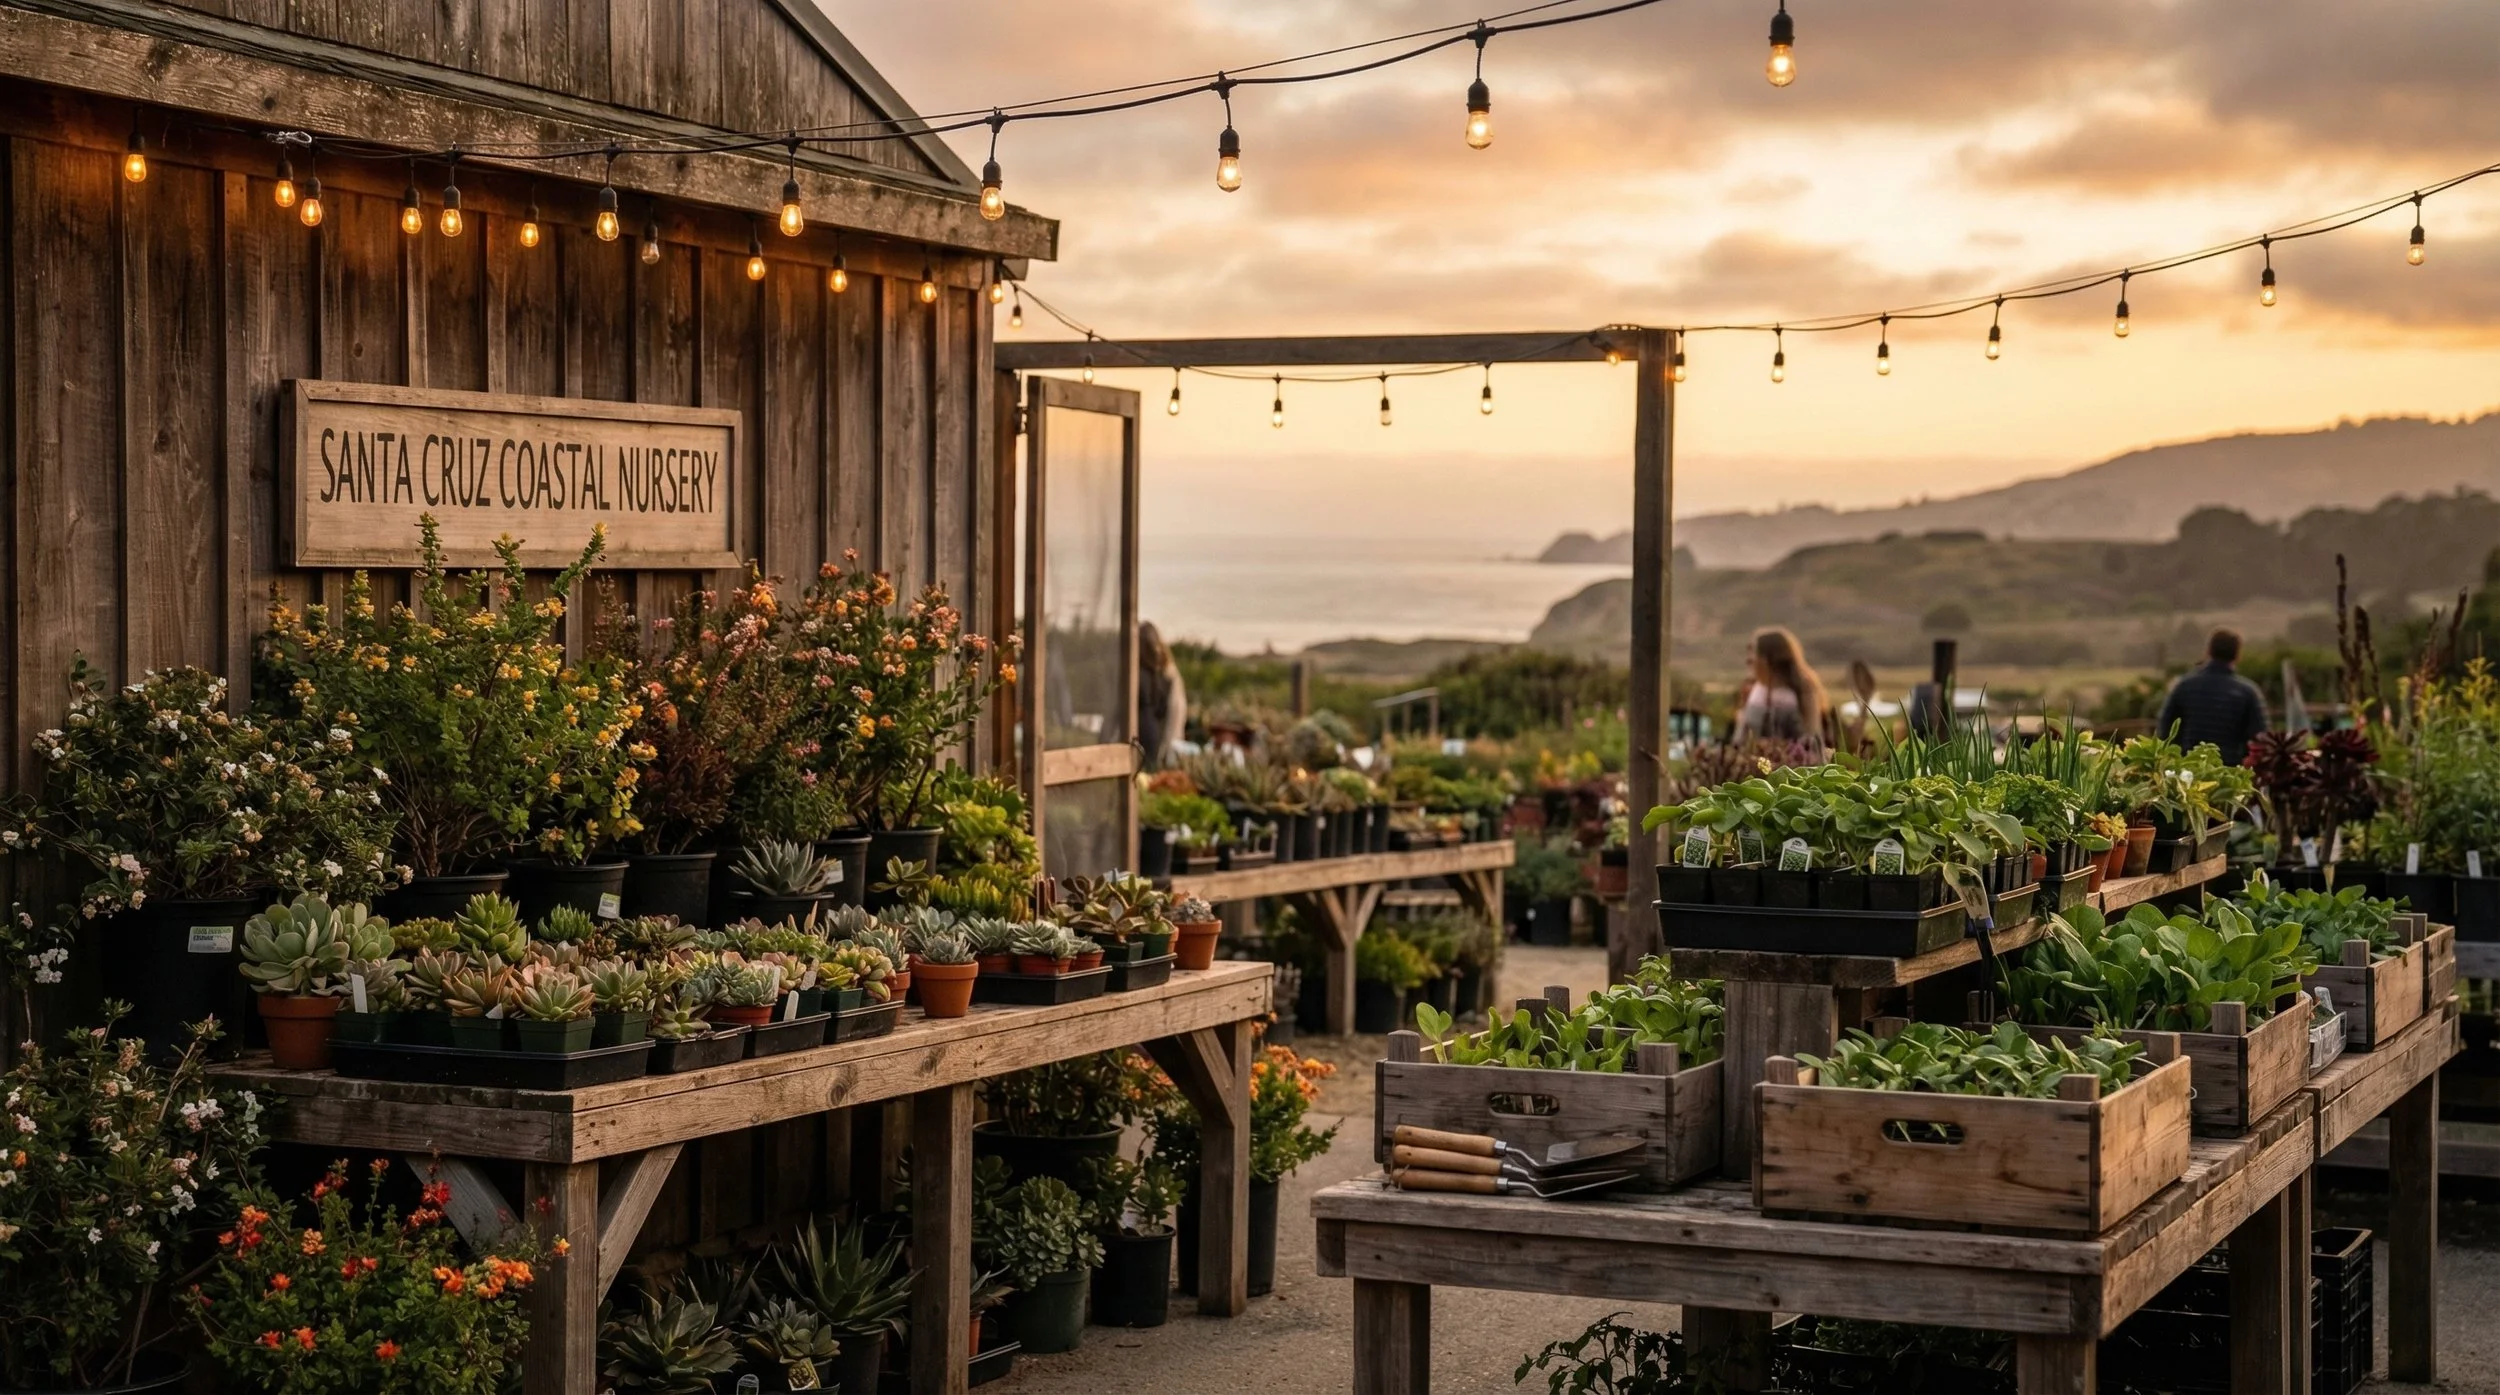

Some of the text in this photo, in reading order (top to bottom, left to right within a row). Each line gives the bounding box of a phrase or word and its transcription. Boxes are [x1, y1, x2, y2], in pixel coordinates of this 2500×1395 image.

[320, 427, 719, 513] SANTA CRUZ COASTAL NURSERY
